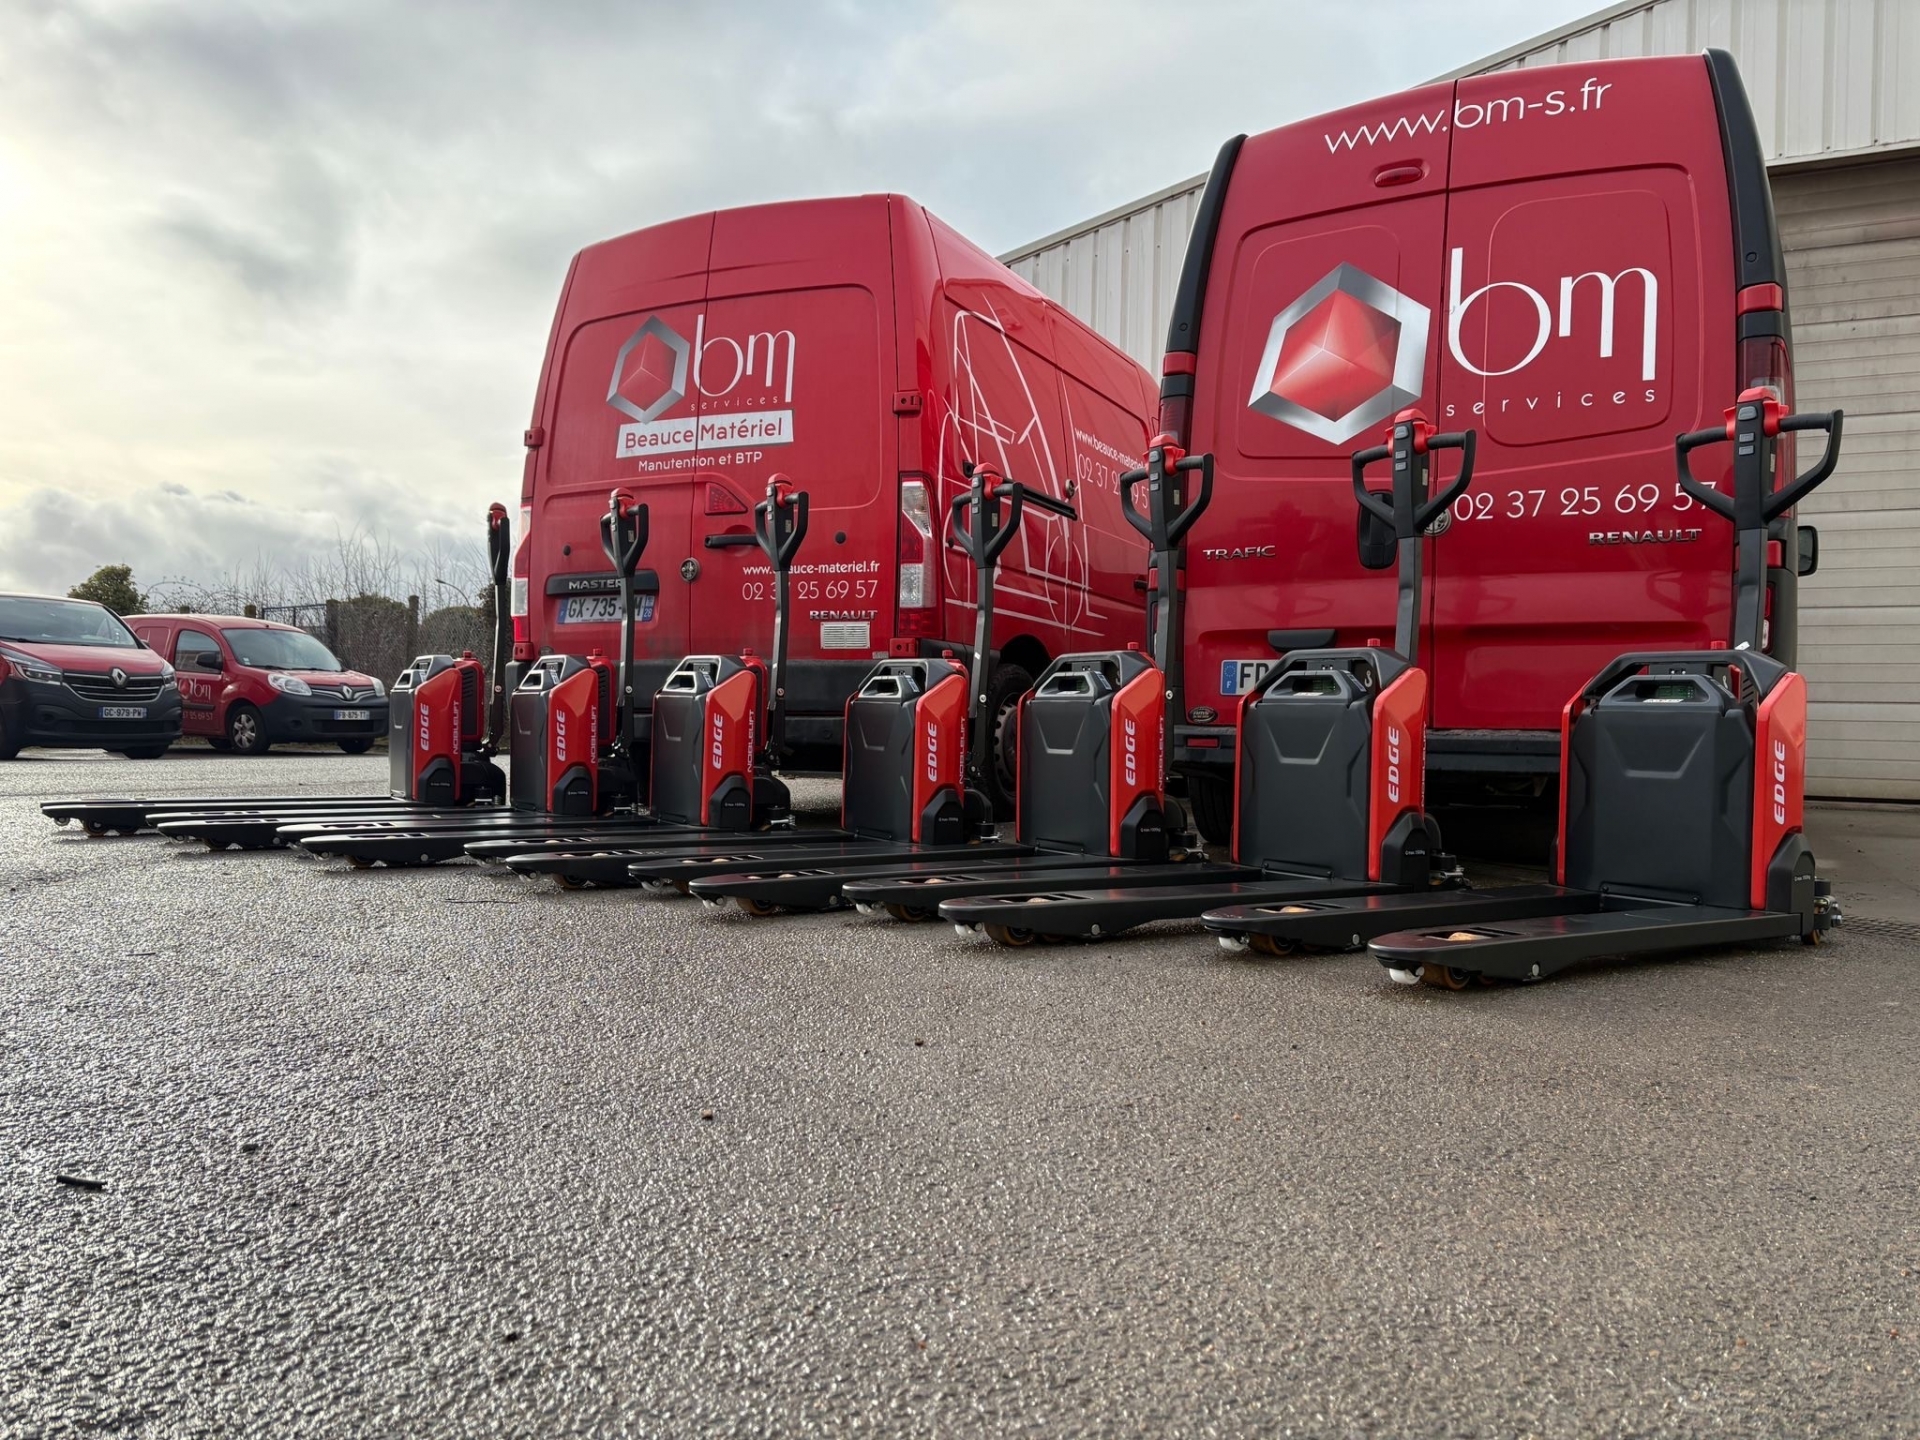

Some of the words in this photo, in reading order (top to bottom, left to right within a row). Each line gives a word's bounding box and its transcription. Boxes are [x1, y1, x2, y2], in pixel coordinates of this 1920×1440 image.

[1324, 77, 1612, 154] www.bm-s.fr
[1448, 247, 1658, 381] bm
[693, 314, 795, 403] bm
[690, 396, 777, 411] services
[1446, 389, 1655, 417] services
[625, 428, 694, 449] Beauce
[700, 417, 782, 441] Matériel
[638, 455, 715, 472] Manutention
[718, 453, 732, 465] et
[735, 451, 763, 464] BTP
[1078, 453, 1094, 483] 02
[1095, 462, 1108, 490] 37
[1111, 470, 1121, 495] 2
[1141, 485, 1150, 509] 5
[1454, 492, 1494, 521] 02
[1506, 490, 1546, 519] 37
[1560, 487, 1602, 516] 25
[1615, 483, 1660, 513] 69
[1202, 545, 1276, 560] TRAFIC
[1589, 528, 1702, 545] RENAULT
[742, 582, 764, 600] 02
[797, 581, 820, 599] 25
[825, 580, 849, 599] 69
[855, 579, 878, 598] 57
[743, 560, 880, 575] www.auce-materiel.fr
[809, 609, 878, 620] RENAULT
[193, 677, 211, 700] bm
[420, 702, 429, 751] EDGE
[556, 709, 566, 762] EDGE
[712, 712, 723, 770] EDGE
[747, 709, 755, 773] NOBLELIFT
[927, 721, 938, 782] EDGE
[1125, 718, 1136, 787] EDGE
[1388, 726, 1399, 803] EDGE
[1774, 739, 1785, 825] EDGE
